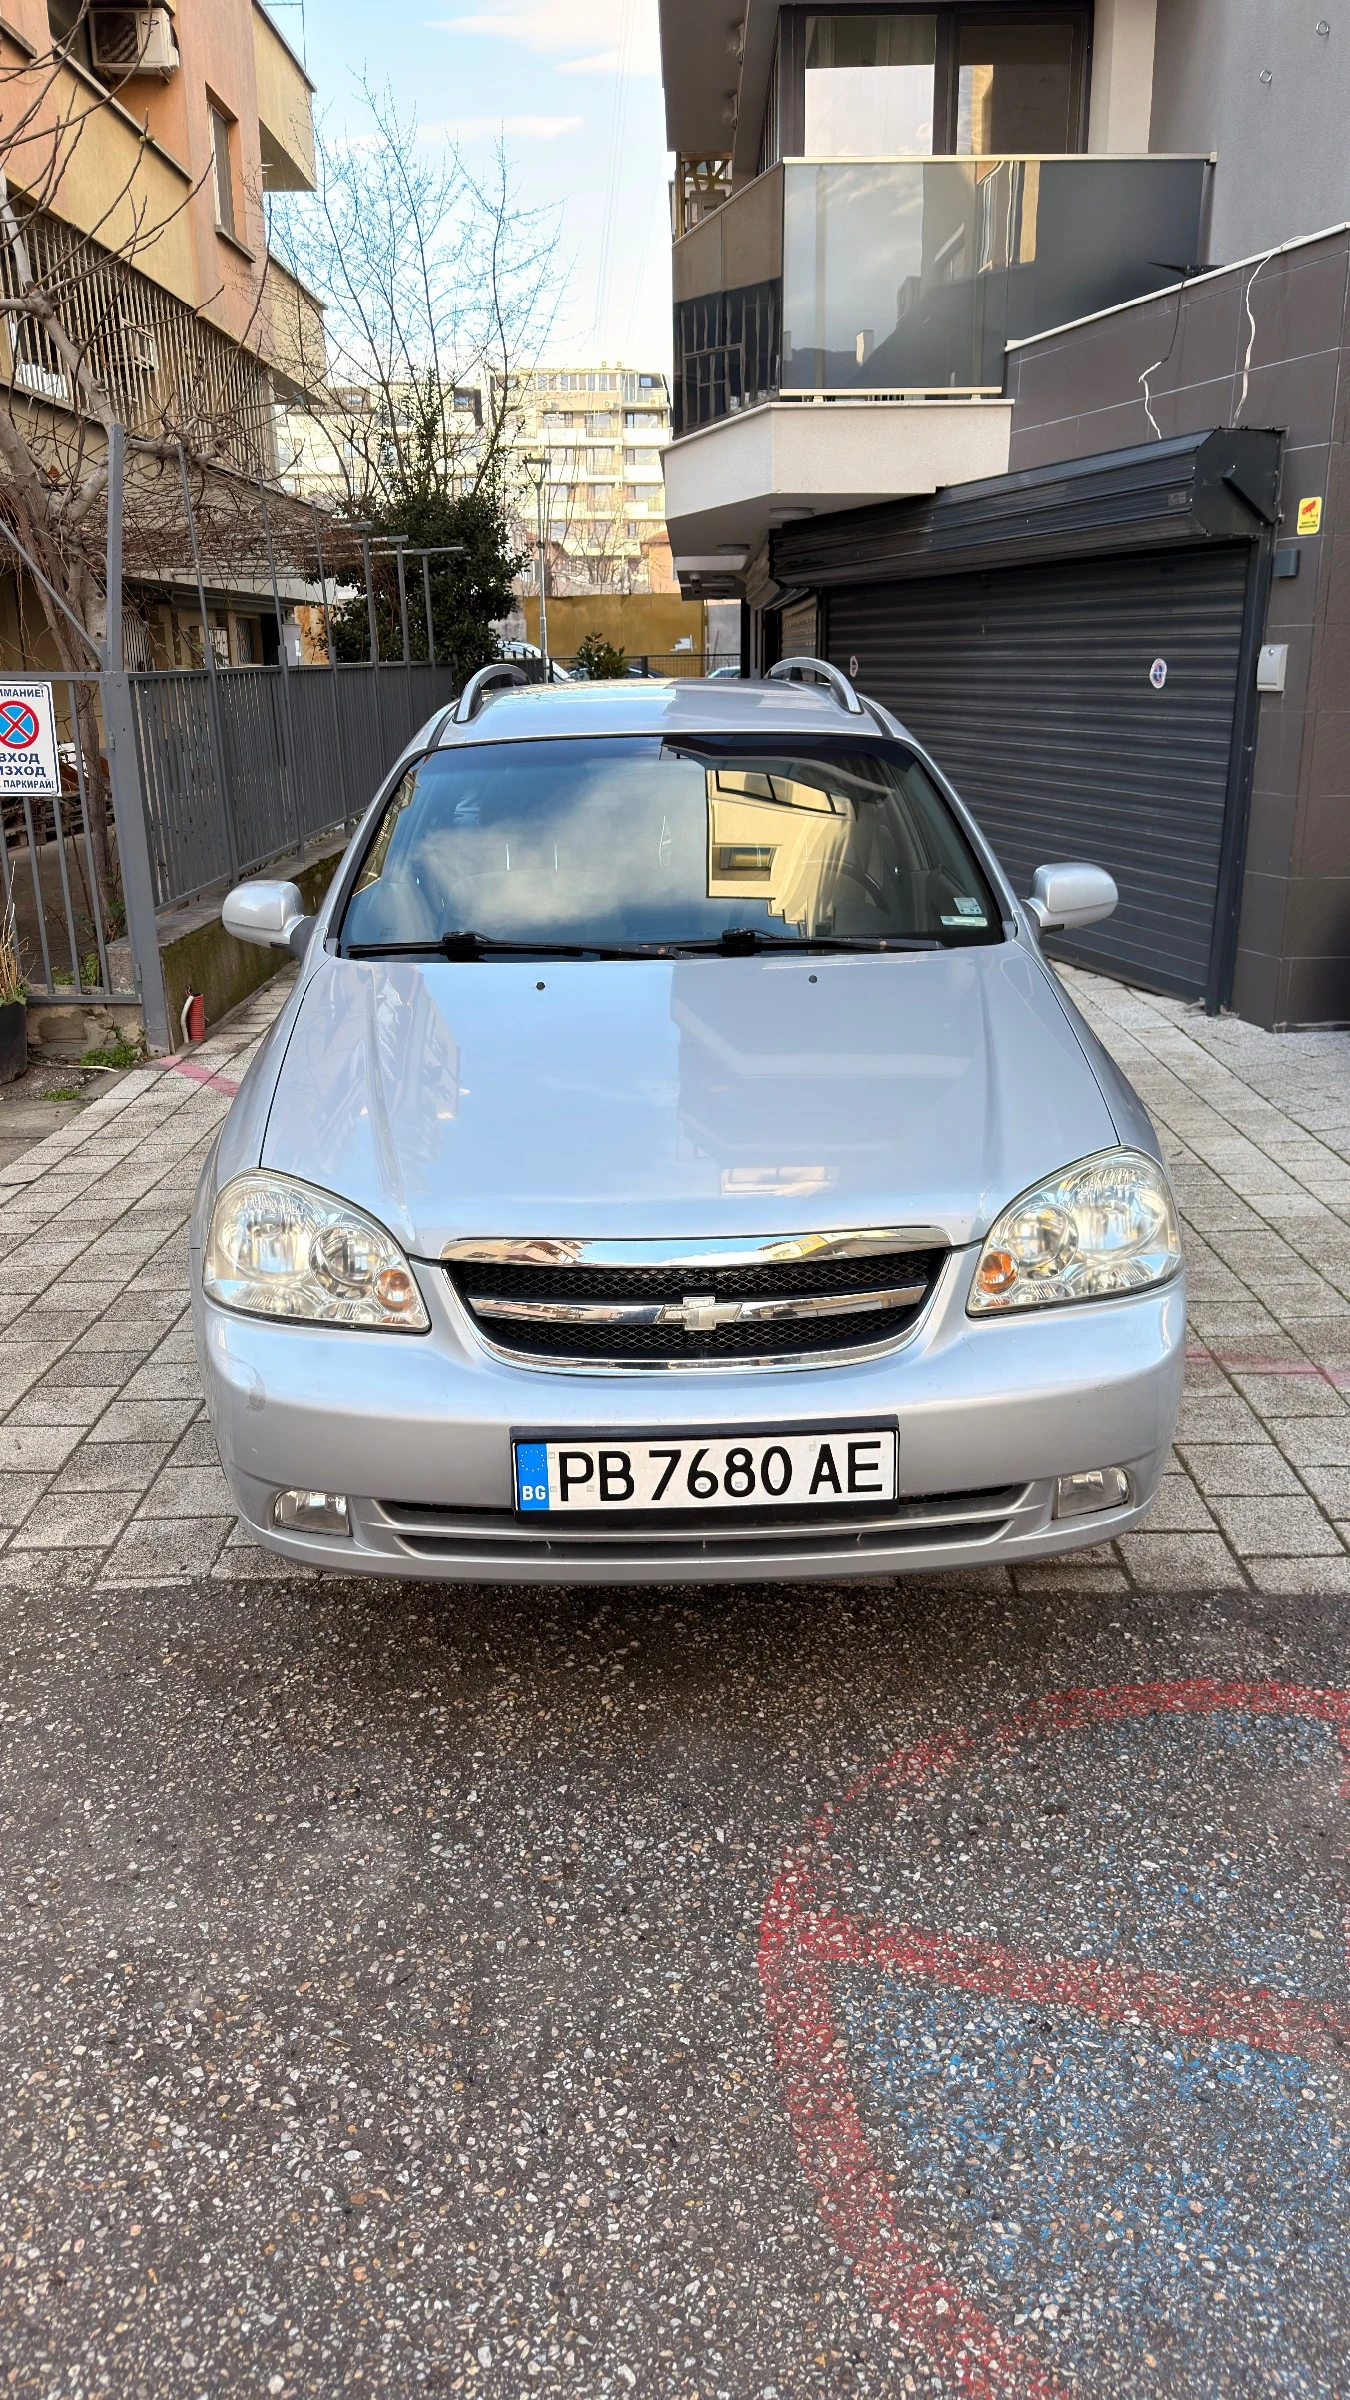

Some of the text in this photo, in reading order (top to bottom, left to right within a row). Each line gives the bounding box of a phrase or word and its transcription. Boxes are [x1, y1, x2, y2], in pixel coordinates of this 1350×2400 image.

[0, 753, 40, 764] ВХОД
[3, 779, 54, 788] ПАРКИРАЙ!
[558, 1441, 883, 1502] PB 7680 AE
[522, 1485, 546, 1500] BG
